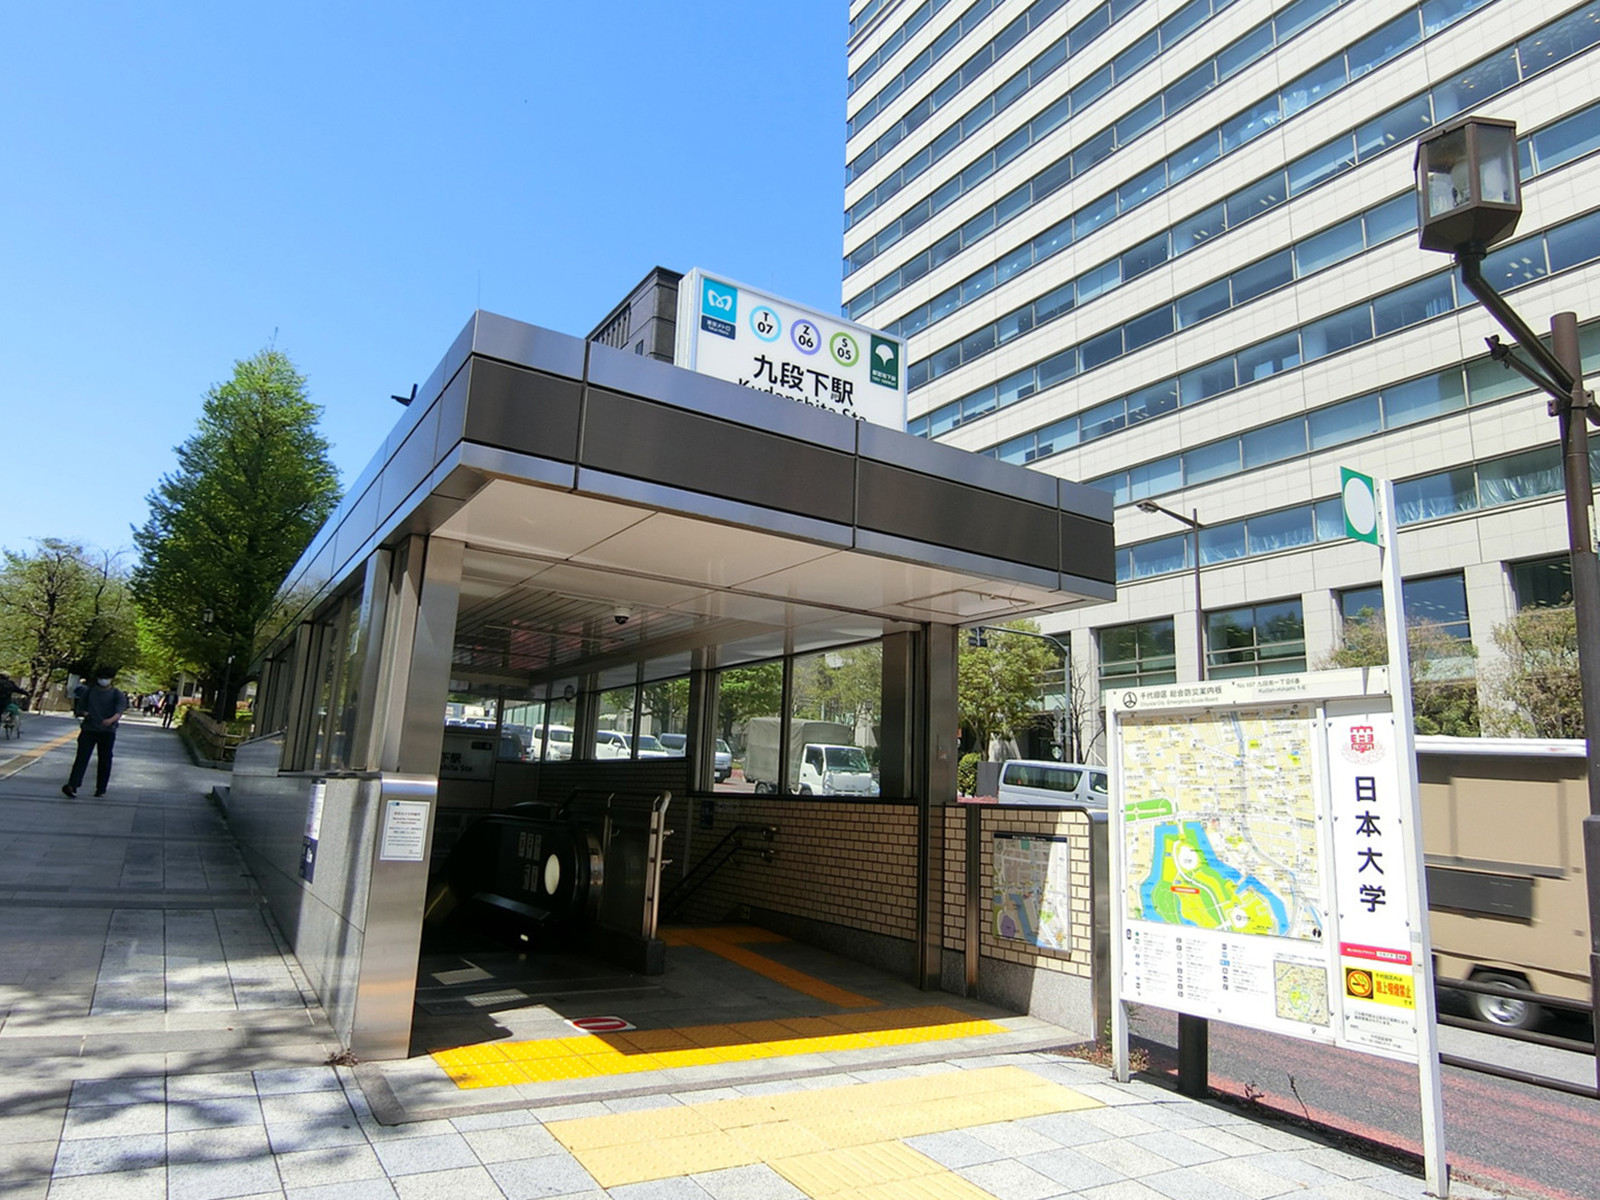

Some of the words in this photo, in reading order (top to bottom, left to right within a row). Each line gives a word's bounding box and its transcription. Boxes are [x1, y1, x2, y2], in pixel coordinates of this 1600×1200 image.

[763, 312, 769, 321] T
[757, 321, 773, 335] 07
[803, 325, 810, 336] Z
[798, 335, 814, 349] 06
[841, 338, 848, 348] S
[837, 347, 852, 360] 05
[753, 354, 854, 407] 九段下駅
[1140, 689, 1168, 700] 千代田区
[1170, 685, 1223, 698] 総合防災案内板
[1355, 776, 1387, 913] 日本大学
